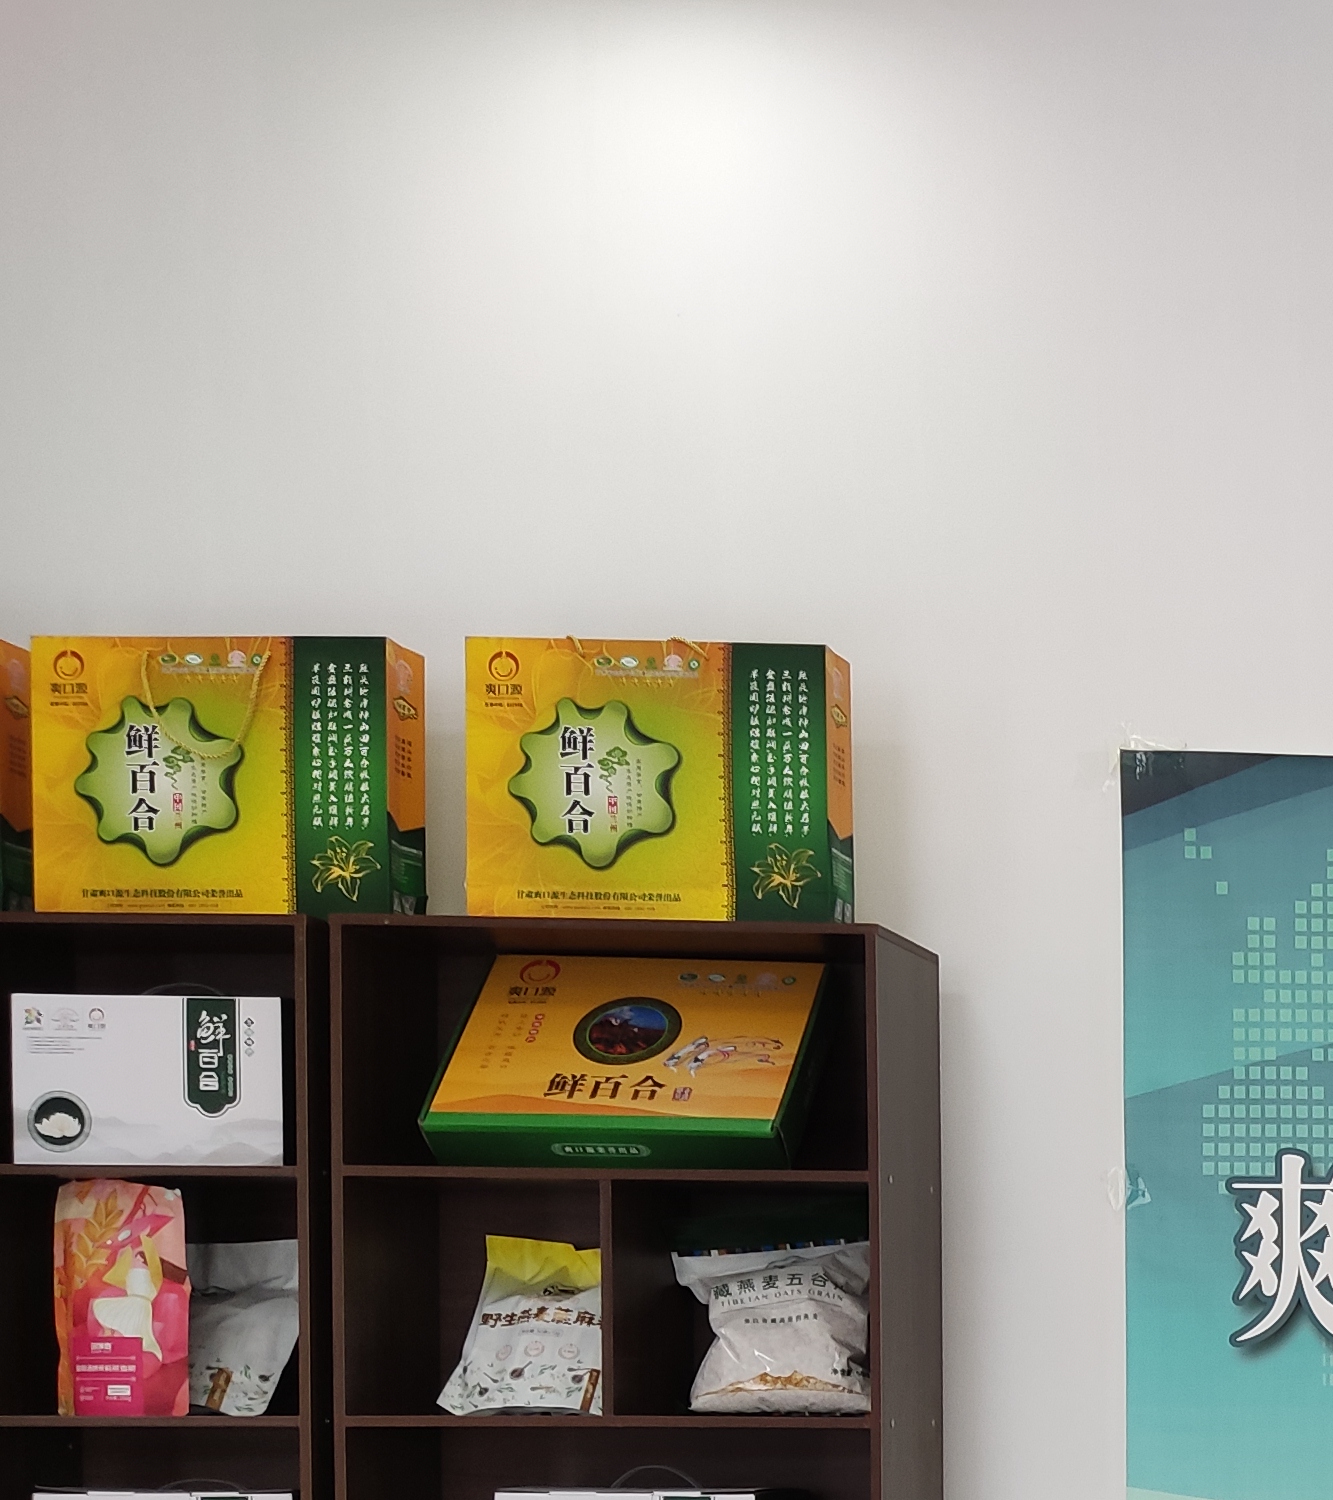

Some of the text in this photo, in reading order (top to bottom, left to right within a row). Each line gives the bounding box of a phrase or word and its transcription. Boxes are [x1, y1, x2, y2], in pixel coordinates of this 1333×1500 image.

[125, 724, 161, 831] 鲜百合
[560, 726, 595, 834] 鲜百合
[196, 1010, 231, 1091] 鲜百合
[543, 1071, 667, 1101] 鲜百合
[711, 1272, 847, 1299] 藏燕麦五谷
